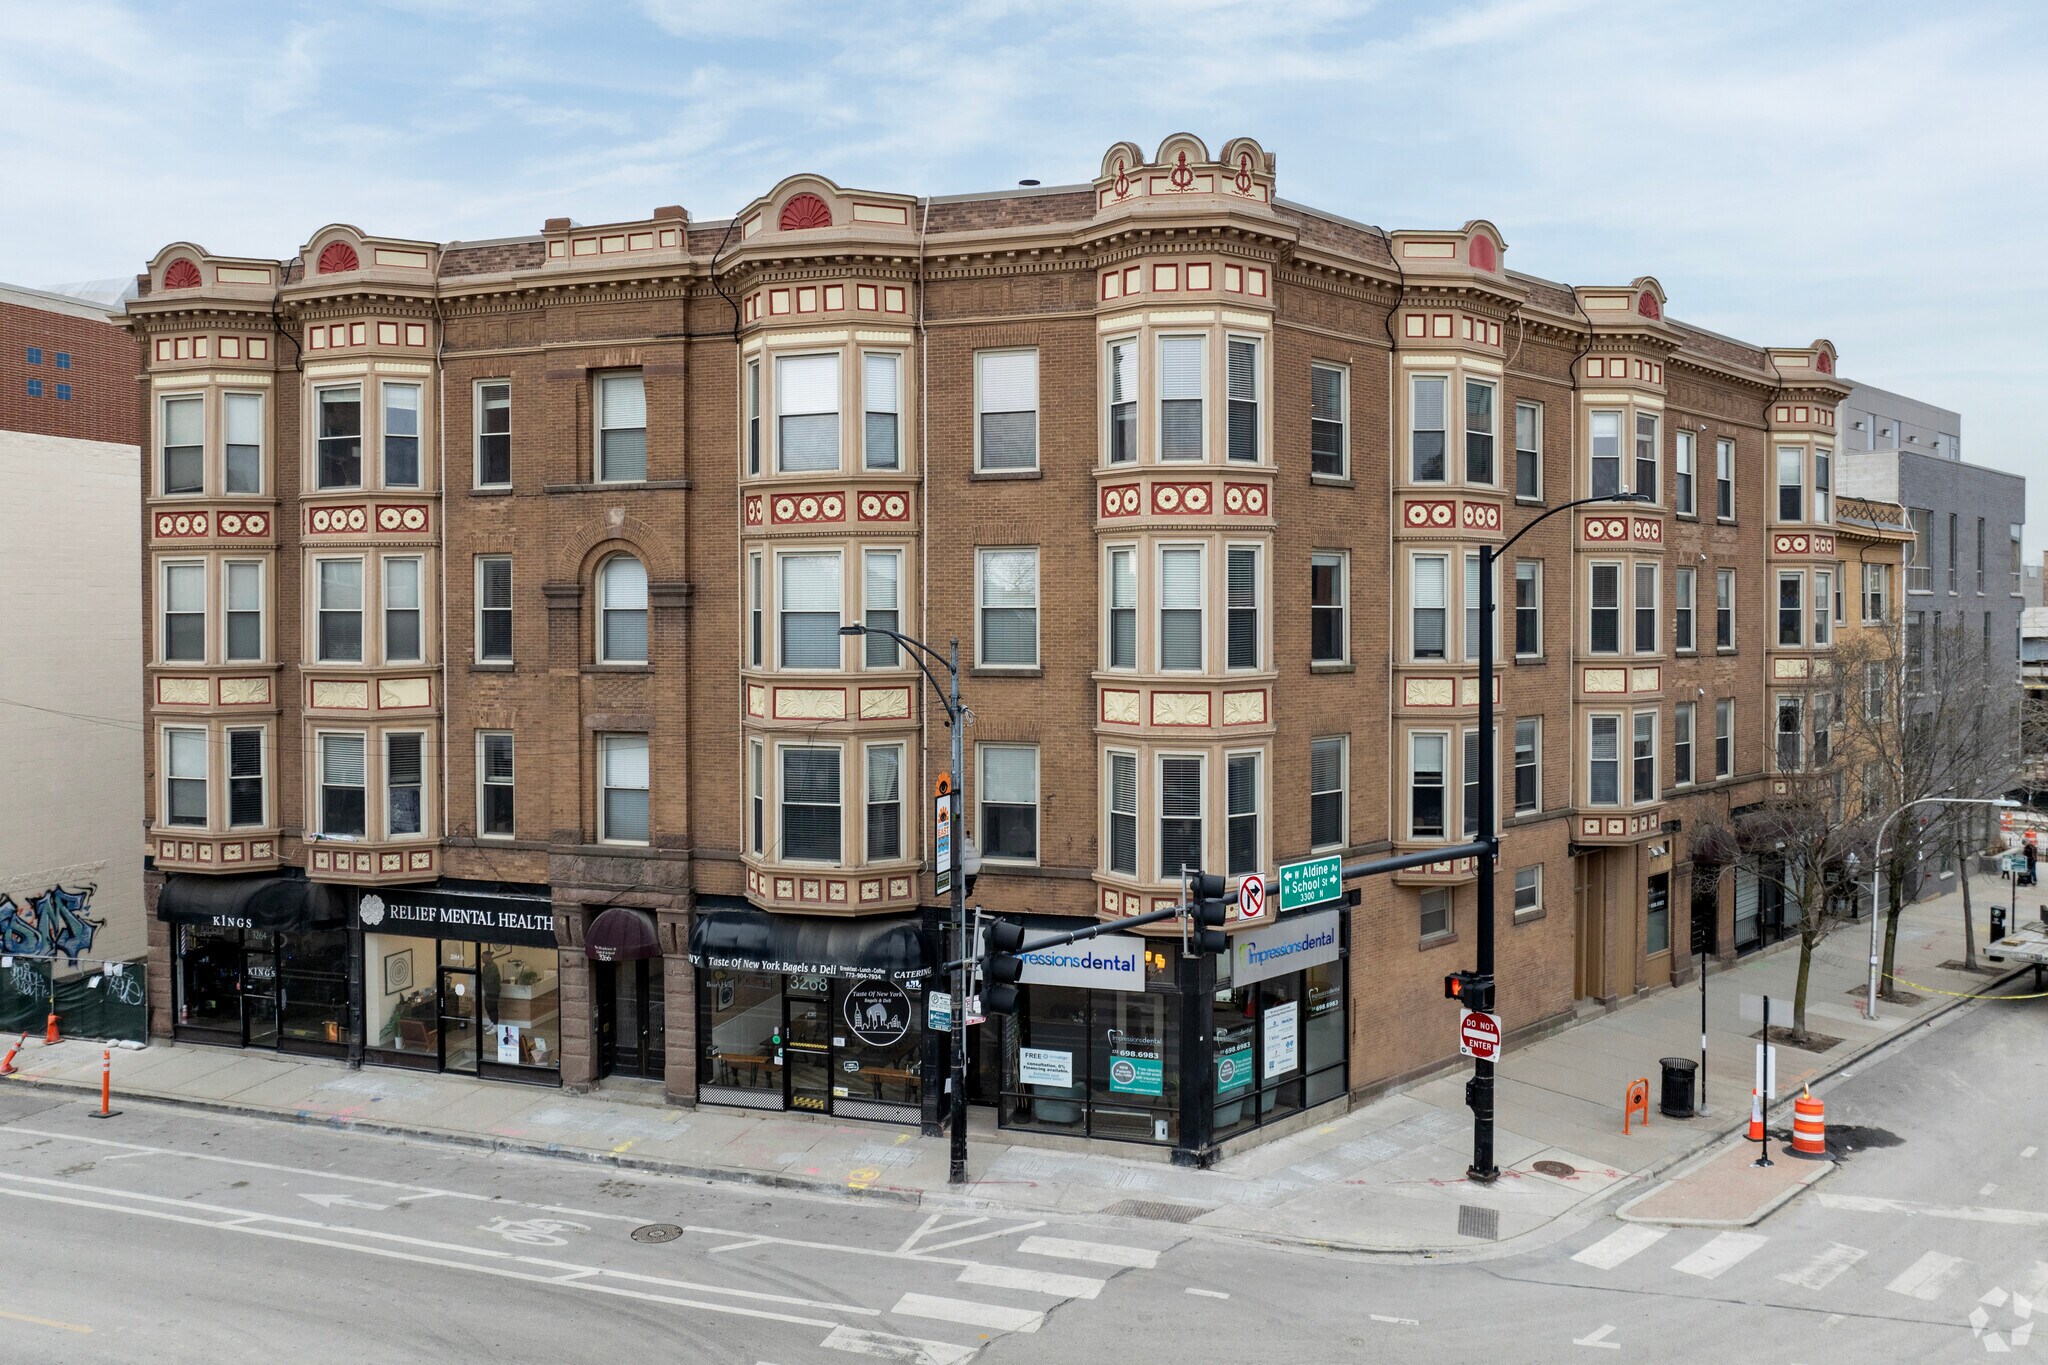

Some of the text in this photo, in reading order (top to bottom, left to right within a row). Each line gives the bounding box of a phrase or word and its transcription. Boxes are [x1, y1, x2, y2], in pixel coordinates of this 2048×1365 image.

[937, 826, 949, 837] EAST
[1294, 864, 1338, 879] W Aldine Av
[1284, 878, 1328, 894] W School St
[1300, 891, 1315, 902] 3300
[390, 904, 554, 931] RELIEF MENTAL HEALTH
[252, 930, 267, 940] 3264
[688, 953, 701, 965] NY
[708, 956, 837, 975] Taste Of New York Bagels & Deli
[893, 966, 932, 979] CATERING
[790, 975, 828, 992] 3268
[1315, 999, 1339, 1012] 698.6983
[1466, 1019, 1494, 1032] DO NOT
[1224, 1041, 1251, 1055] 698.6983
[1469, 1040, 1492, 1051] ENTER
[1024, 1052, 1042, 1060] FREE
[1119, 1049, 1159, 1060] 698.6983
